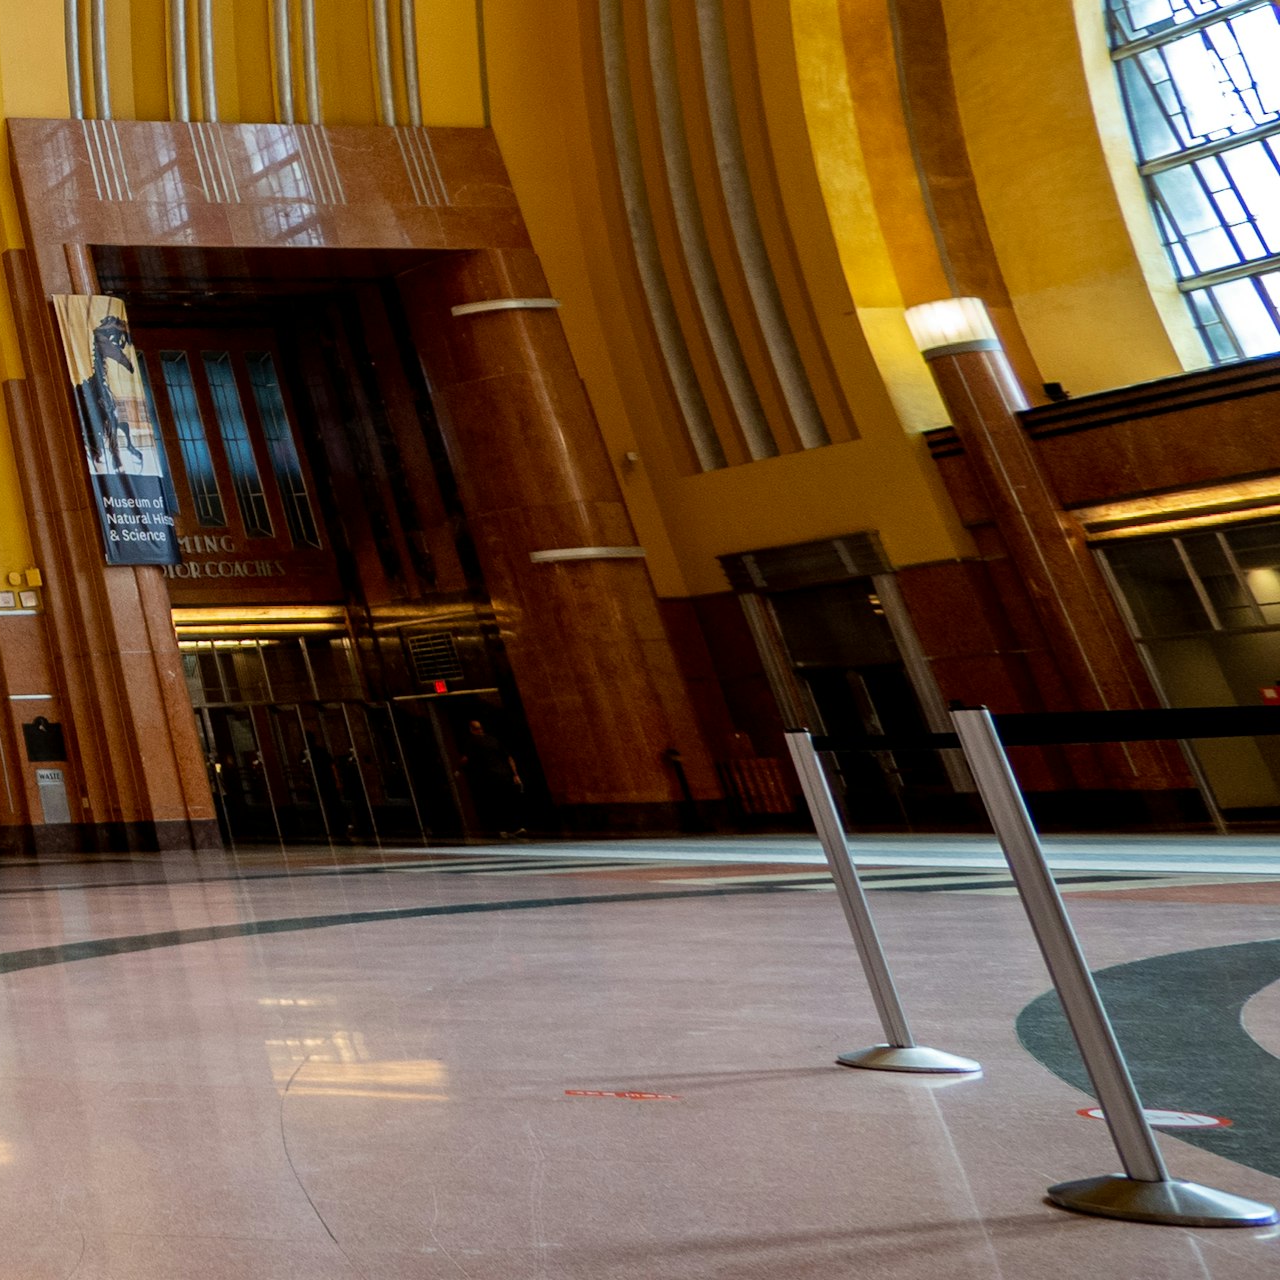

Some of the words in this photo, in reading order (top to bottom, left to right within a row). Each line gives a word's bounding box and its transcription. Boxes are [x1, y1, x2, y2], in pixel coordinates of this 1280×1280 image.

[103, 496, 151, 508] Museum
[152, 496, 164, 509] of
[106, 512, 151, 525] Natural
[110, 529, 120, 541] &
[122, 528, 167, 541] Science
[204, 560, 286, 578] COACHES
